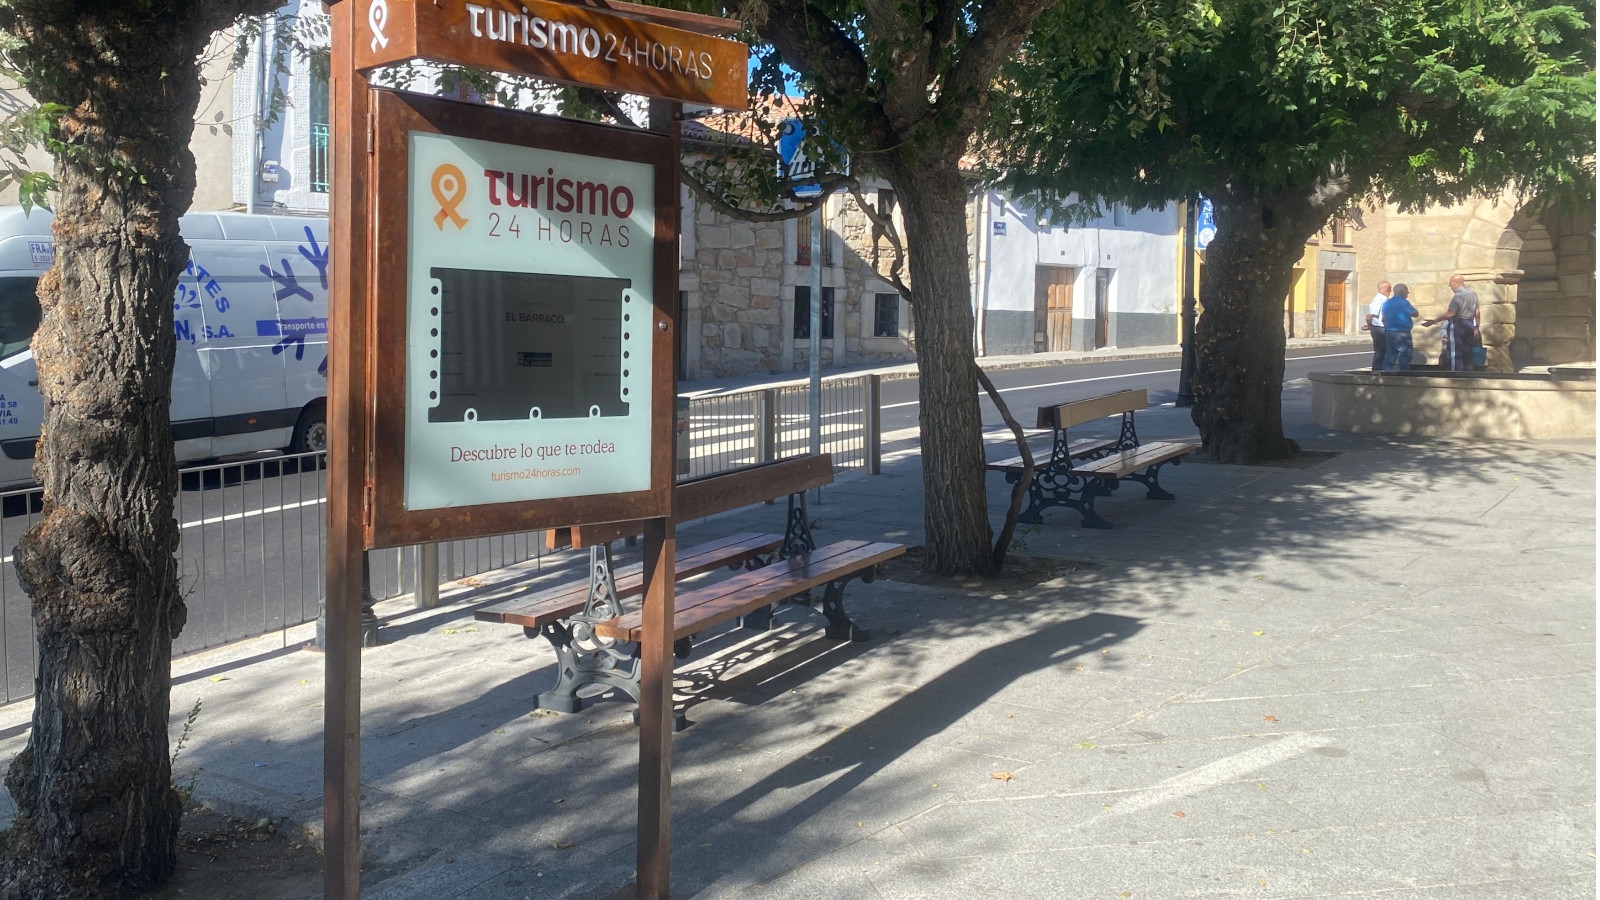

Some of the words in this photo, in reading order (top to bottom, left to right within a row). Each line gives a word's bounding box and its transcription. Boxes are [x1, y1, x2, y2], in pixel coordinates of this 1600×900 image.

[465, 2, 601, 59] turismo
[603, 32, 714, 81] 24HORAS
[484, 167, 634, 219] turismo
[488, 212, 521, 239] 24
[538, 217, 631, 248] HORAS
[505, 312, 517, 322] EL
[519, 312, 564, 324] BARRACO
[202, 325, 235, 339] S.A.
[275, 321, 315, 332] Transporte
[8, 417, 18, 425] 49
[450, 444, 517, 463] Descubre
[520, 443, 533, 458] lo
[536, 445, 561, 461] que
[565, 443, 577, 456] te
[580, 439, 615, 455] rodea
[491, 466, 581, 482] turismo24horas.com
